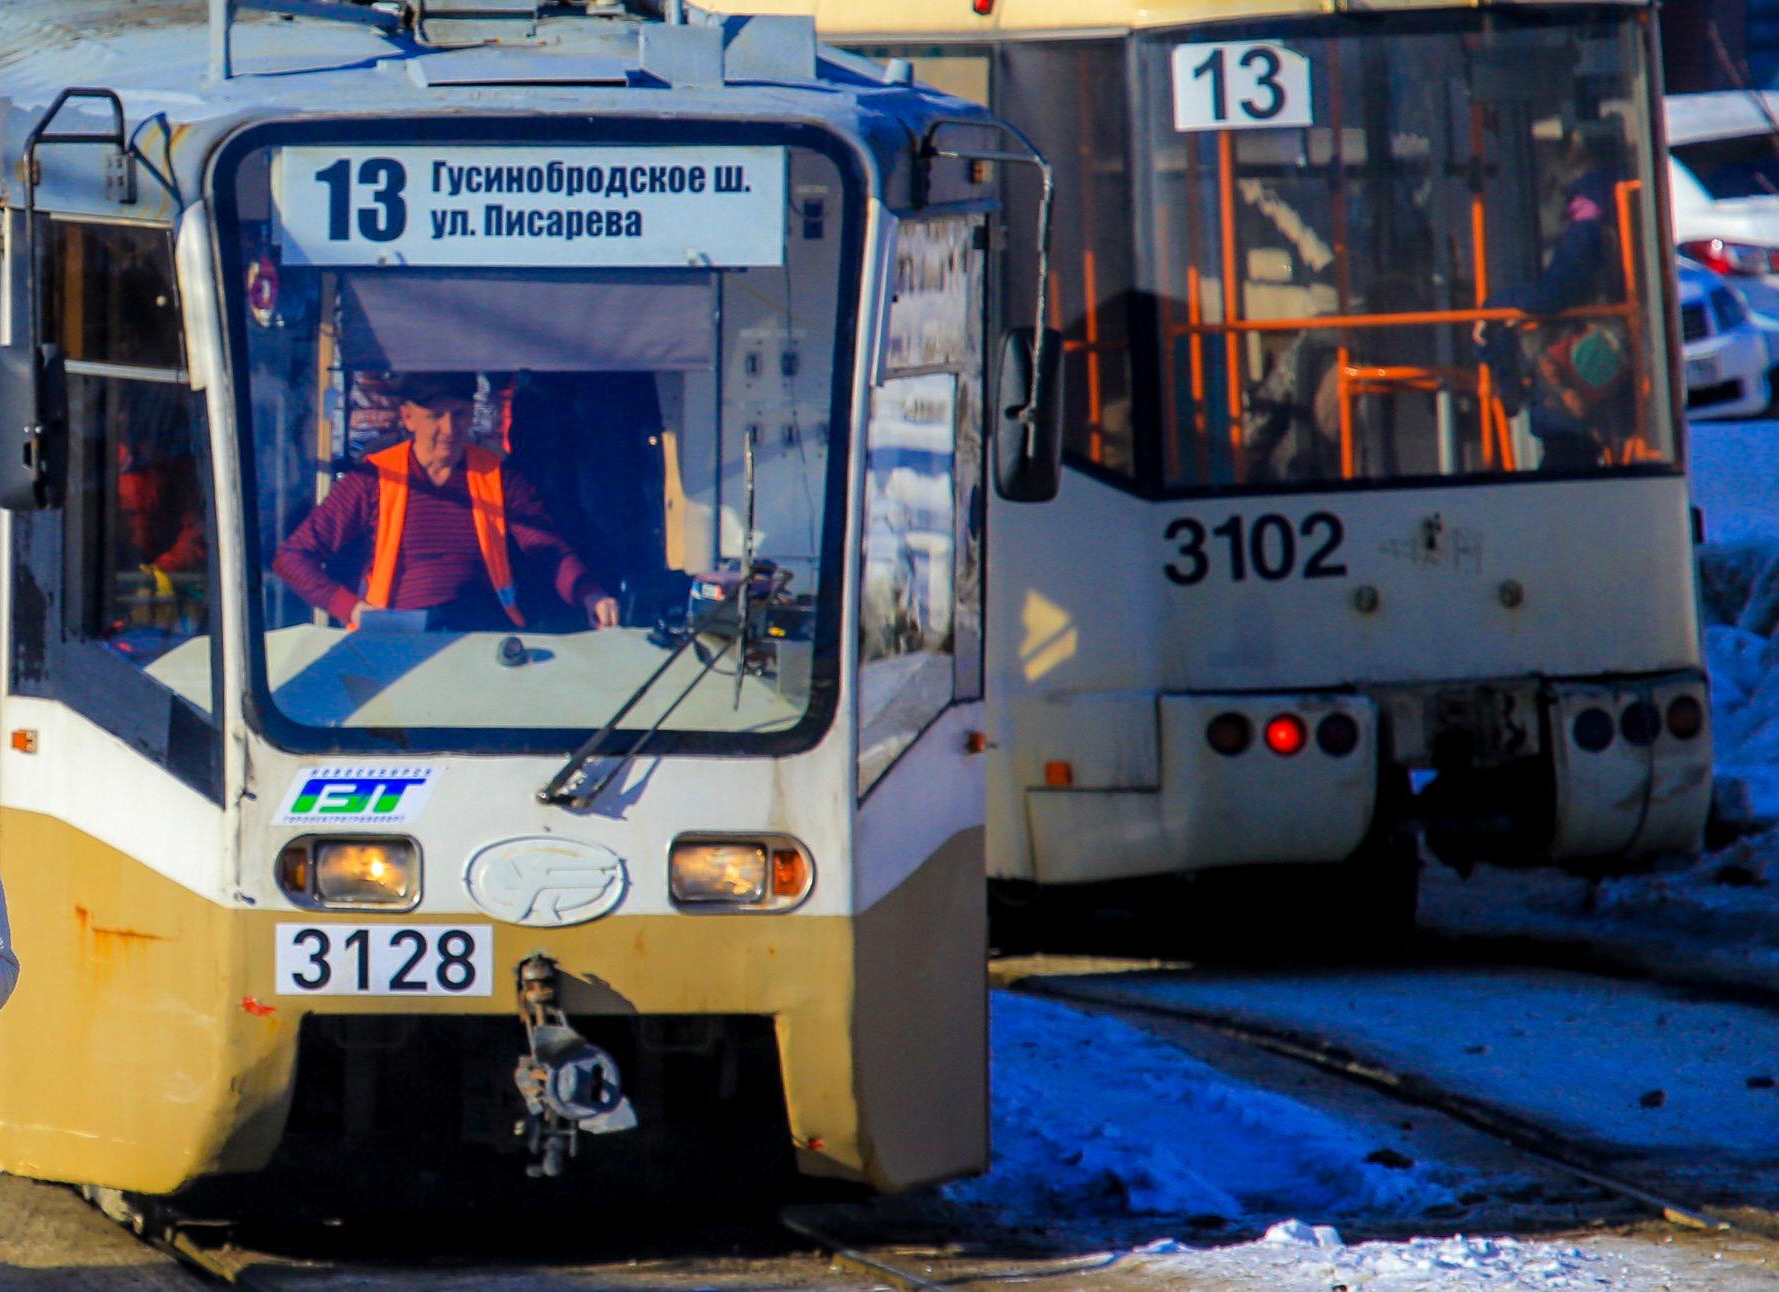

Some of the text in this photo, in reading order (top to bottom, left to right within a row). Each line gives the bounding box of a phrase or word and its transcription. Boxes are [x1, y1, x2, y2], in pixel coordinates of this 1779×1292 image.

[1194, 47, 1286, 119] 13
[315, 157, 408, 242] 13
[431, 160, 751, 197] Гусинобродское ш.
[431, 204, 643, 240] ул. Писарева
[1163, 511, 1348, 586] 3102
[292, 928, 476, 992] 3128
